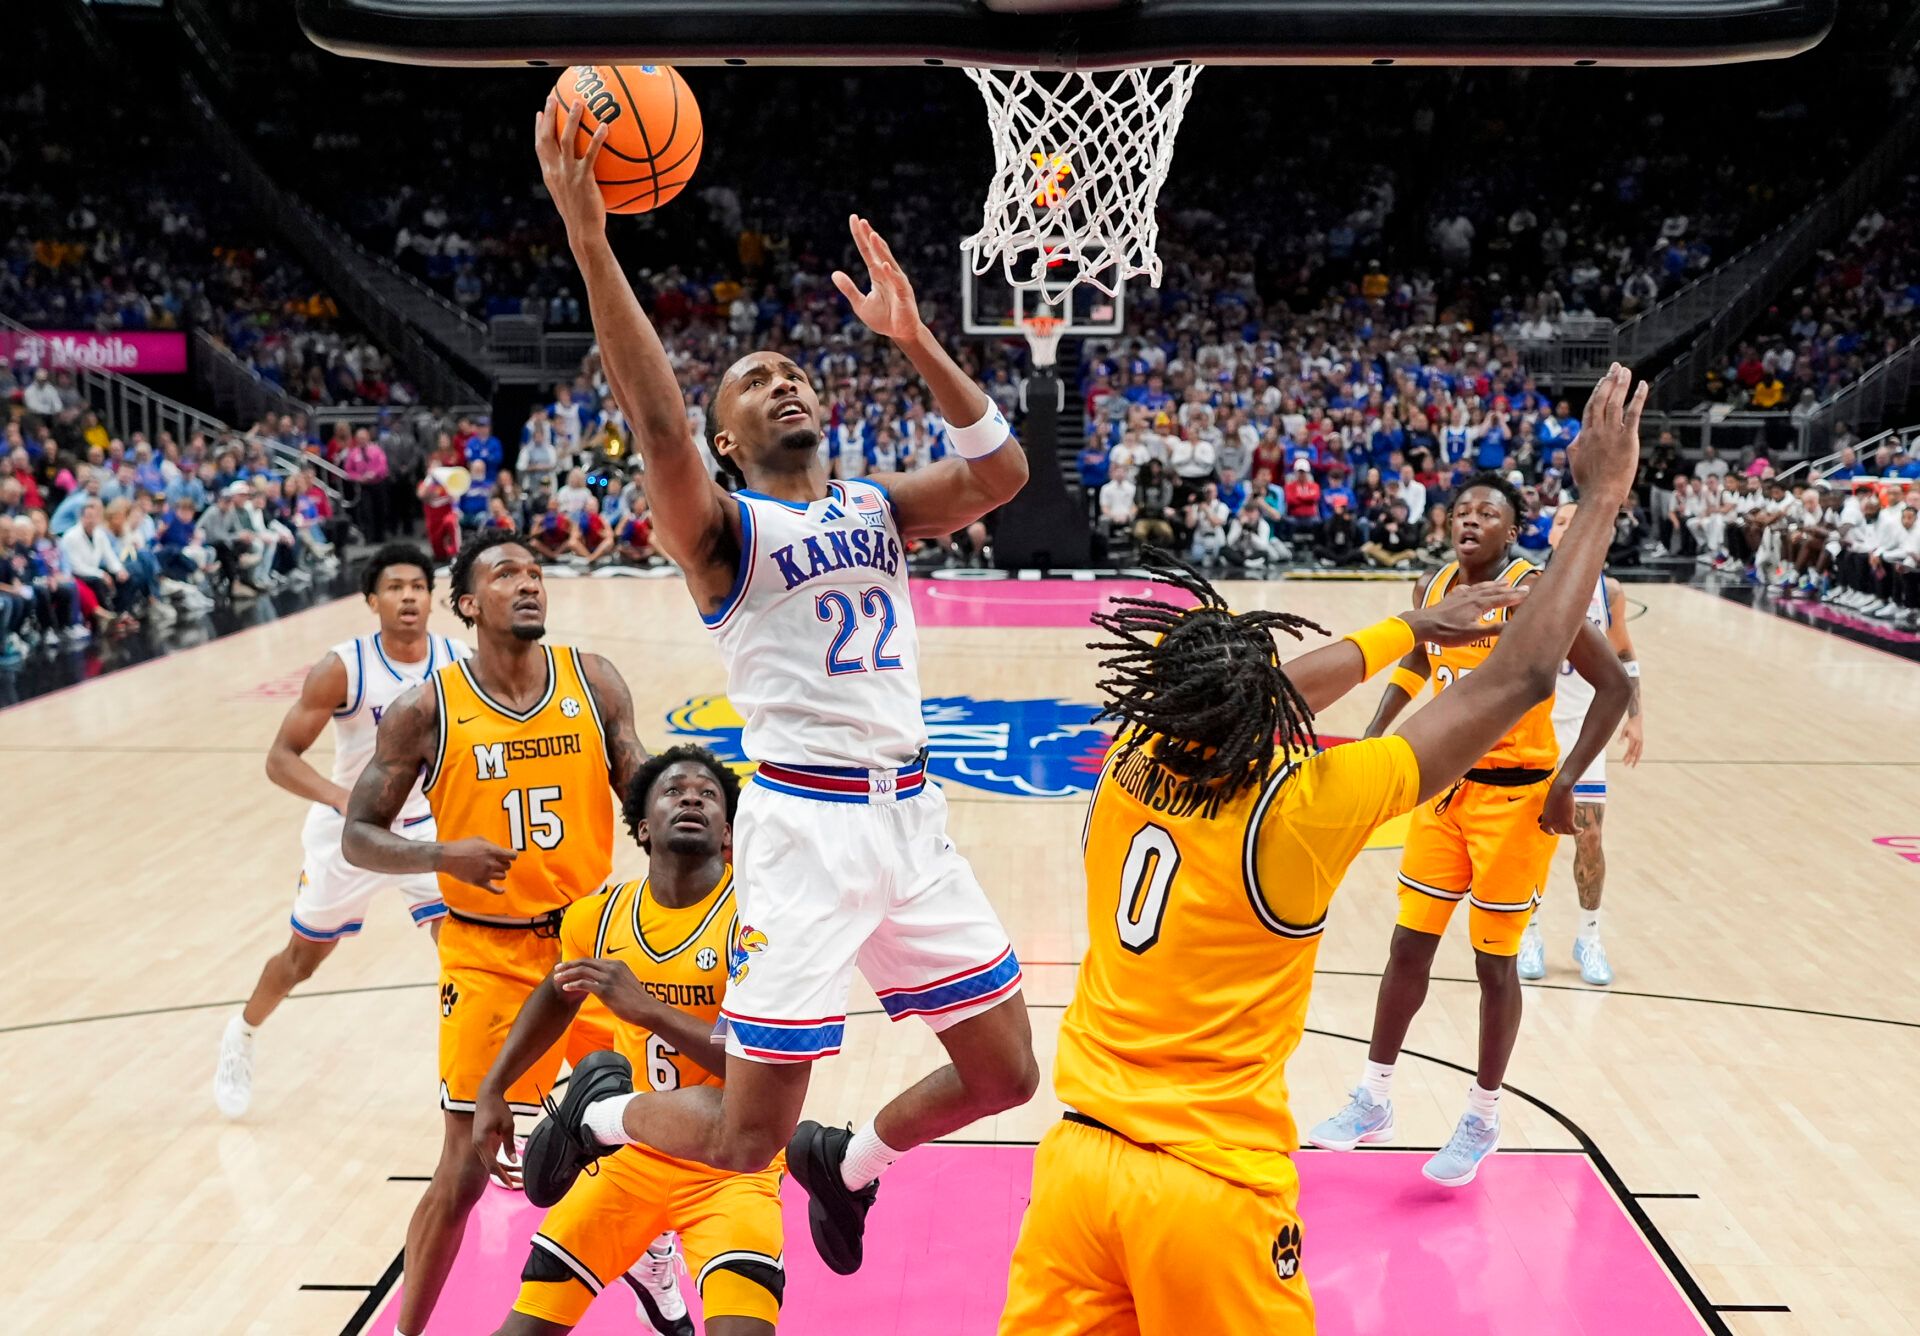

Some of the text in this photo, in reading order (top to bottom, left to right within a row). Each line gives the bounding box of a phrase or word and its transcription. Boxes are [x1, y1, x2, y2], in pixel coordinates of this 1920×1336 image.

[571, 66, 621, 124] Wils
[770, 528, 900, 590] KANSAS
[815, 586, 903, 677] 22
[1436, 665, 1475, 691] 2
[473, 734, 582, 780] MISSOURI
[875, 780, 892, 794] KU
[502, 786, 563, 851] 15
[1115, 821, 1182, 955] 0
[696, 947, 717, 970] SEC
[641, 982, 716, 1005] SSOURI
[646, 1033, 680, 1092] 6
[1278, 1259, 1295, 1276] M
